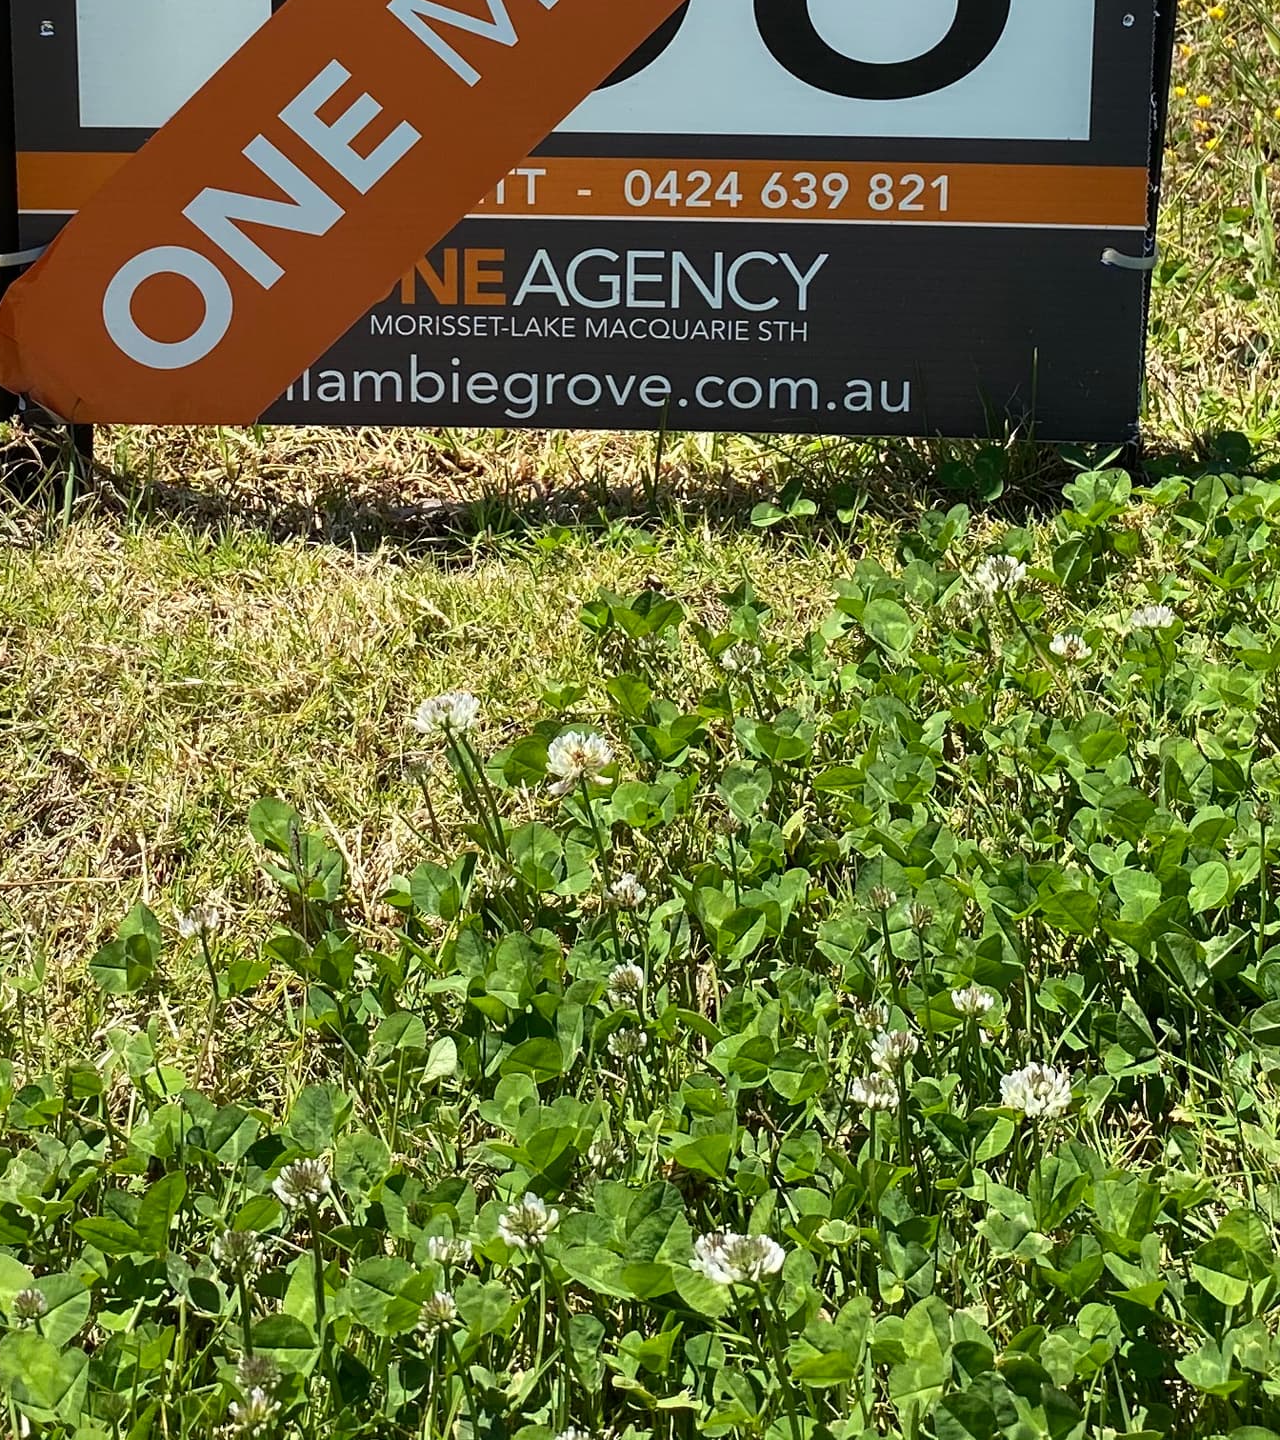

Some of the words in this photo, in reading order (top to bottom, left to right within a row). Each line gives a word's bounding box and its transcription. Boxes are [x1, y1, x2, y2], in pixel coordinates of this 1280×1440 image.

[624, 169, 743, 208] 0424
[761, 172, 849, 210] 639
[868, 173, 949, 211] 821
[102, 58, 422, 370] ONE
[370, 314, 576, 338] MORISSET-LAKE
[585, 317, 750, 341] MACQUARIE
[758, 320, 808, 343] STH
